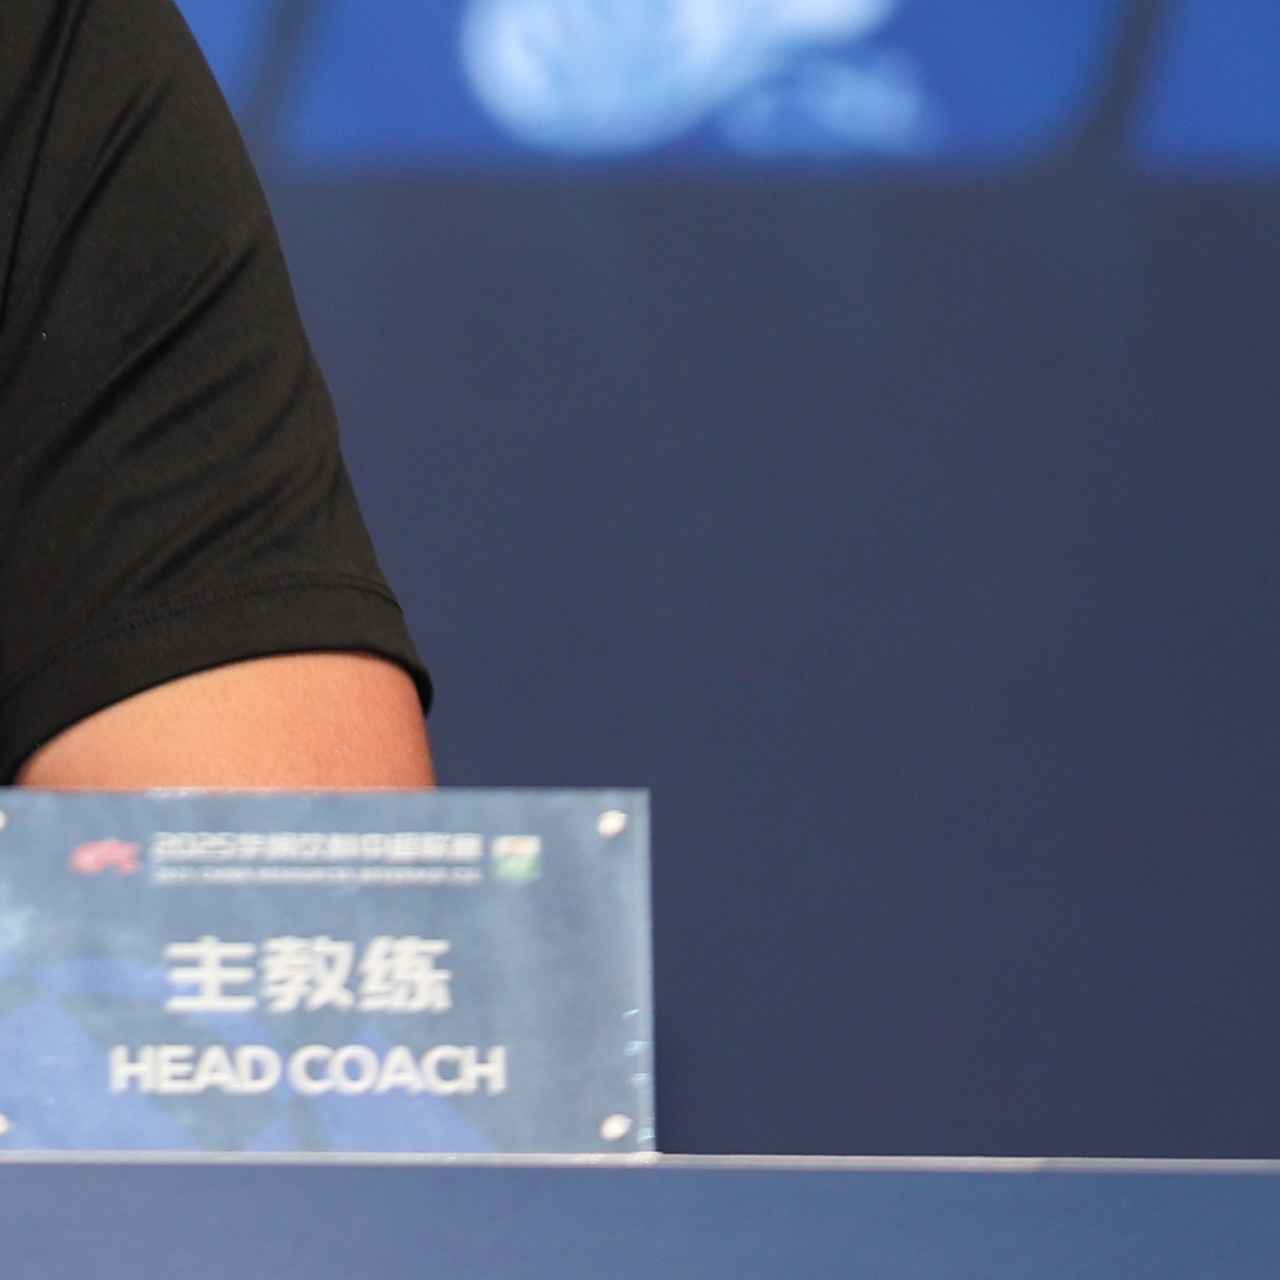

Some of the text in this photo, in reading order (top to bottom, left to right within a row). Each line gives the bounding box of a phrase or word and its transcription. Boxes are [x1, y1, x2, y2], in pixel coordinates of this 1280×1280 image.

[163, 935, 453, 1015] 主教练
[108, 1044, 507, 1096] HEAD COACH
